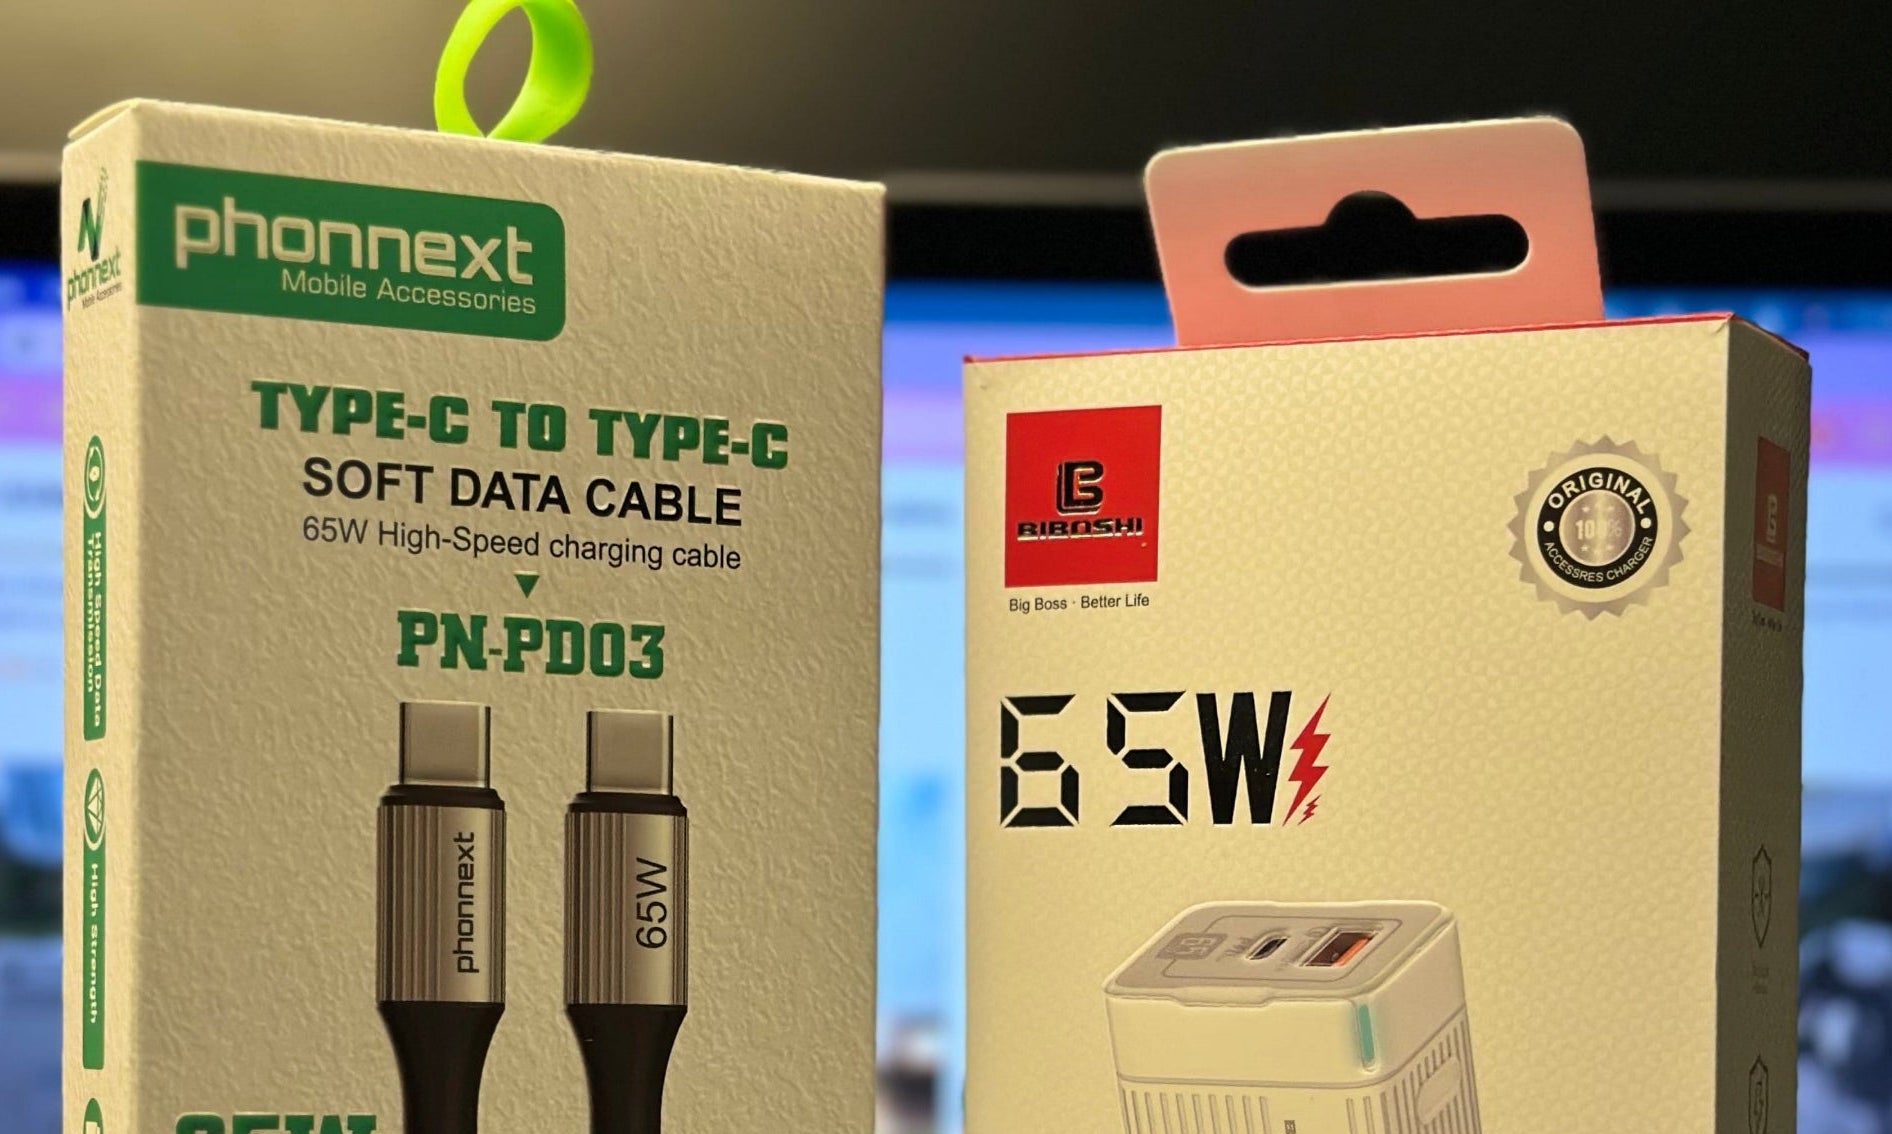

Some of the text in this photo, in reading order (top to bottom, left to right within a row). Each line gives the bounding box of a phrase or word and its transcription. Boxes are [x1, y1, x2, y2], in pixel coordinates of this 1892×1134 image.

[175, 197, 534, 286] phonnext
[281, 269, 536, 315] Mobile Accessories
[251, 380, 789, 470] TYPE-C TO TYPE-C
[302, 456, 742, 527] SOFT DATA CABLE
[1548, 471, 1651, 515] ORIGINAL
[302, 515, 742, 570] 65W High-Speed charging cable
[1017, 517, 1143, 541] BIBOSHI
[1606, 536, 1653, 581] CHARGER
[1009, 593, 1150, 614] Big Boss Better Life
[397, 610, 665, 680] PN-PD03
[453, 831, 479, 974] phonnext
[636, 857, 668, 949] 65W
[90, 863, 99, 1024] High Strength
